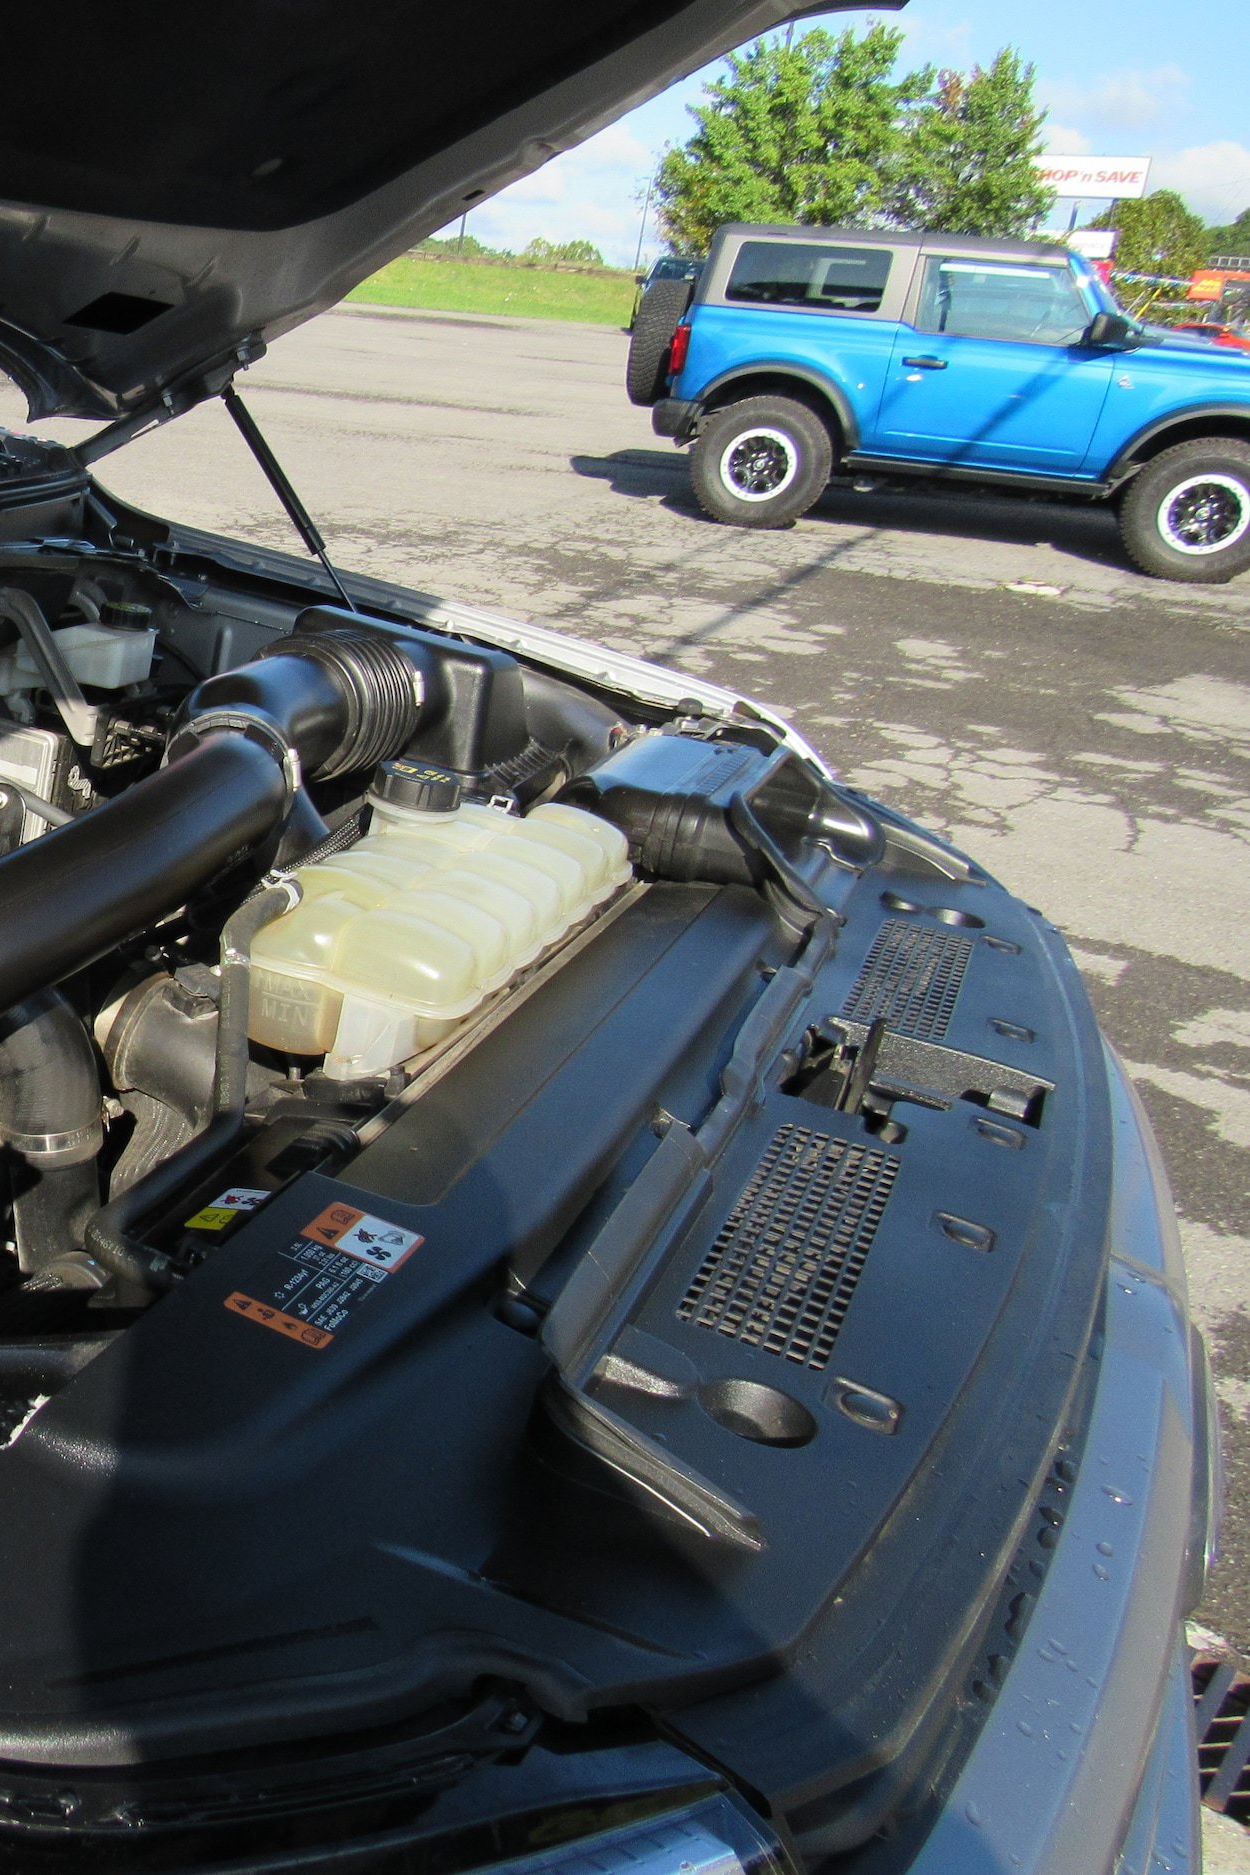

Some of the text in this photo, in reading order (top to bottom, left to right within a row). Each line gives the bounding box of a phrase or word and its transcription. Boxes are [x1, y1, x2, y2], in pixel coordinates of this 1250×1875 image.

[1094, 171, 1143, 183] SAVE
[261, 999, 308, 1027] MIN
[324, 1308, 349, 1332] FoMoCo
